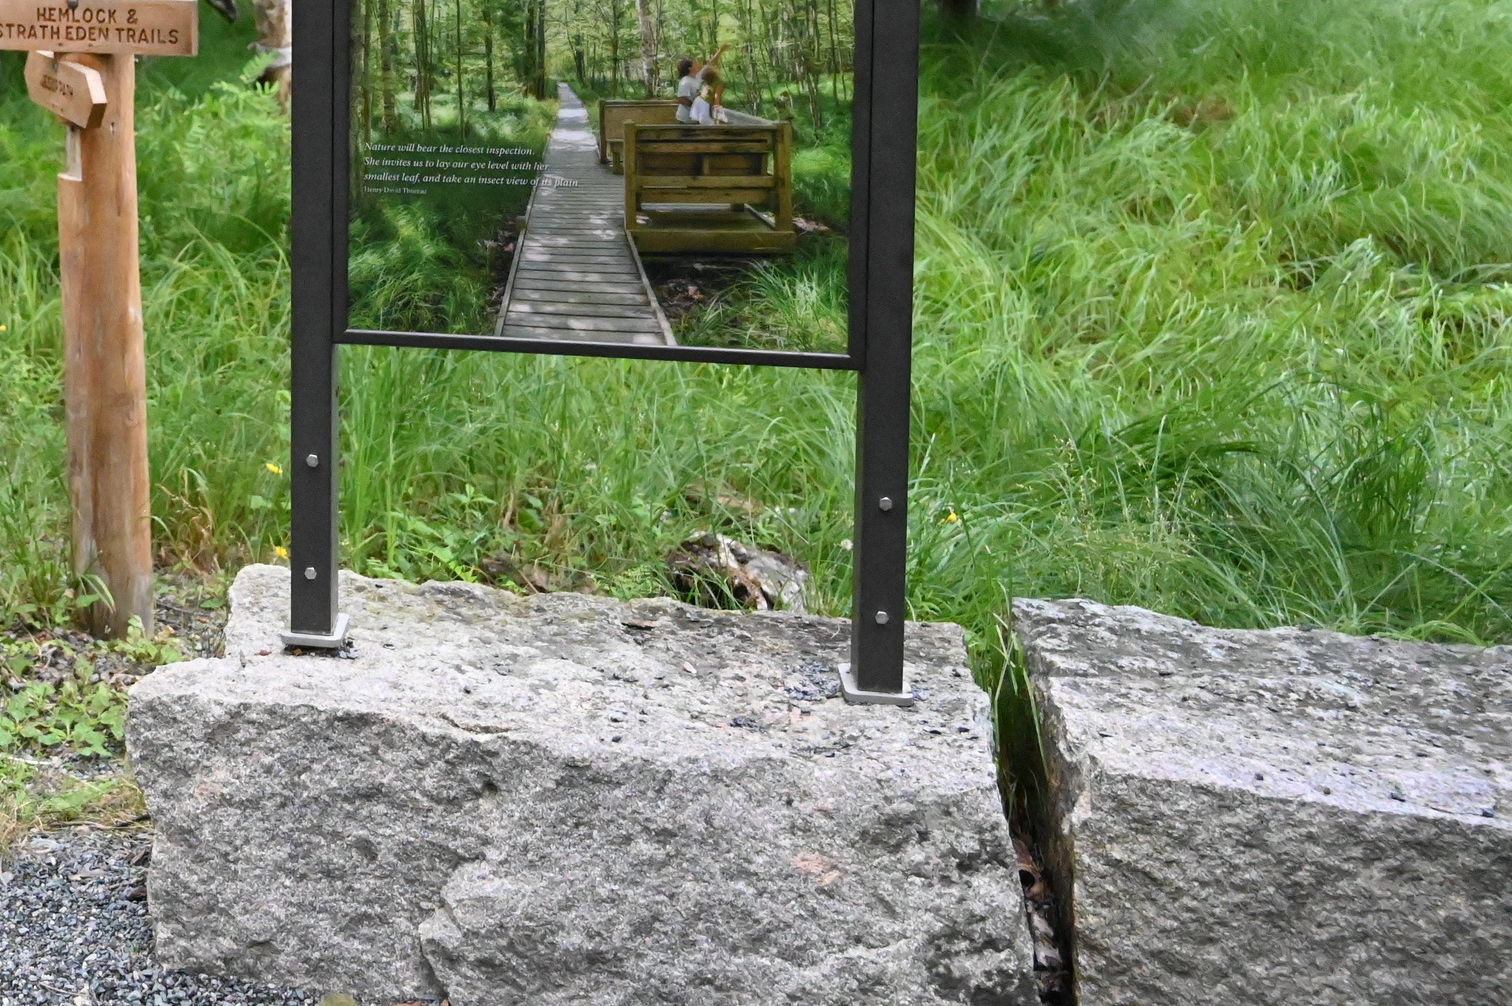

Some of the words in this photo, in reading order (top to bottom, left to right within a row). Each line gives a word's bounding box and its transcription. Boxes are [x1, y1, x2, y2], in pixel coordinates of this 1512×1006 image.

[36, 7, 116, 24] HEMLOCK
[127, 8, 138, 24] &
[115, 28, 179, 45] TRAILS
[364, 143, 395, 151] Nature
[397, 144, 414, 152] will
[416, 144, 437, 152] bear
[439, 145, 453, 153] the
[455, 145, 483, 154] closest
[486, 146, 535, 158] inspection.
[364, 158, 379, 166] She
[381, 158, 410, 167] invites
[425, 159, 434, 167] to
[436, 160, 450, 170] lay
[470, 163, 485, 171] eye
[487, 161, 508, 169] level
[510, 162, 531, 170] with
[533, 162, 550, 170] her
[364, 173, 399, 182] smallest
[401, 174, 420, 184] leaf,
[422, 174, 440, 183] and
[442, 175, 461, 183] take
[478, 176, 503, 184] insect
[506, 177, 528, 185] view
[529, 177, 538, 188] of
